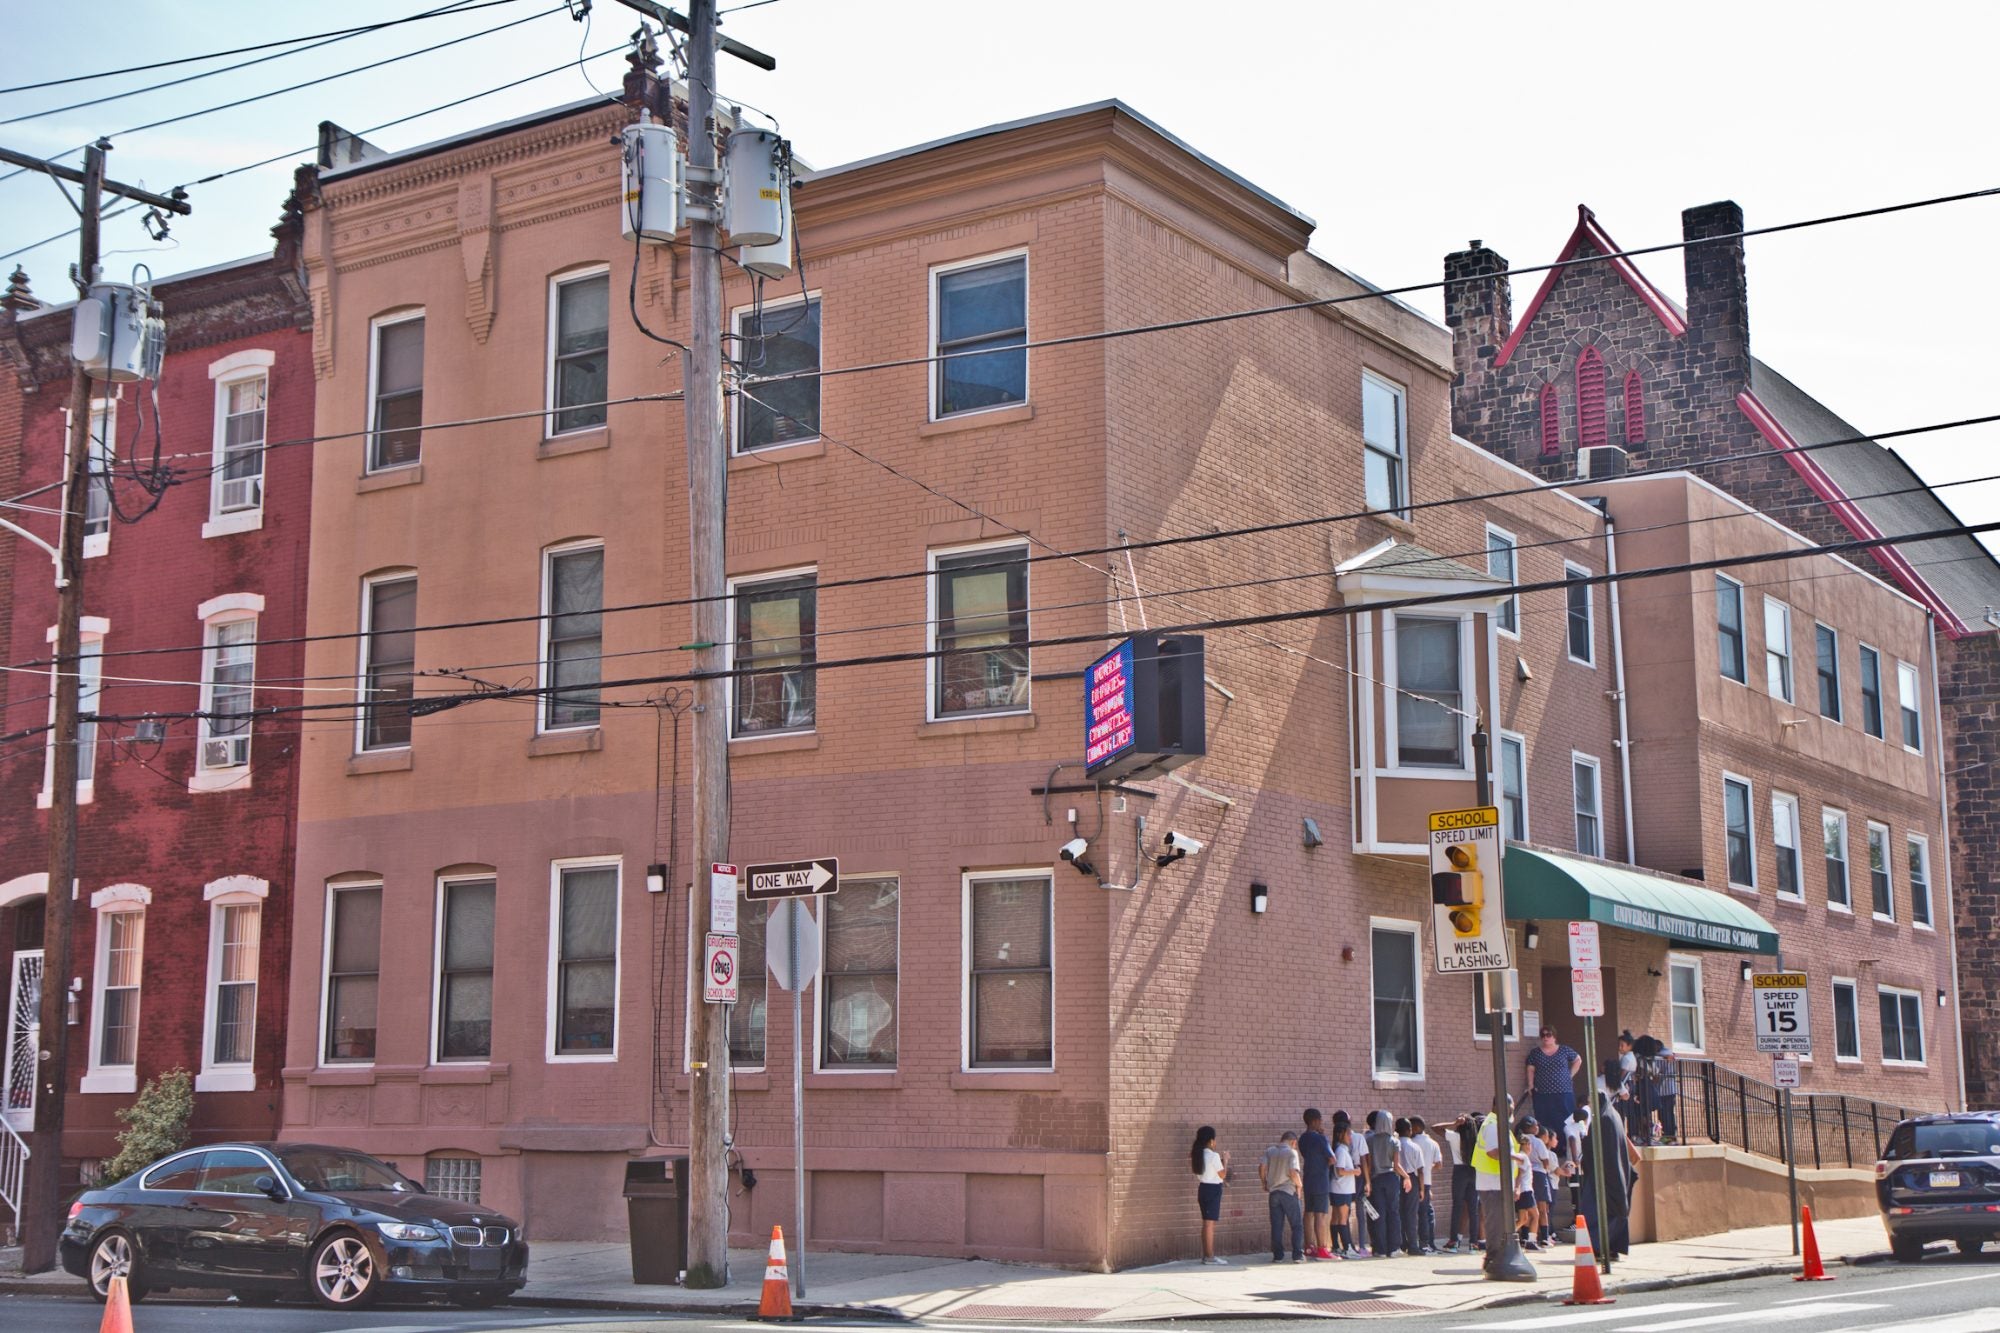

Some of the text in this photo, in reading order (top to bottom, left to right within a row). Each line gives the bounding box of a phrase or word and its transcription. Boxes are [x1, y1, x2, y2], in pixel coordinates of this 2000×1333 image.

[1438, 812, 1490, 828] SCHOOL
[1435, 827, 1493, 844] SPEED LIMIT
[755, 871, 811, 889] ONE WAY
[1613, 904, 1759, 949] UNIVERSAL INSTITUTE CHARTER SCHOOL
[708, 937, 737, 949] DRUG-FREE
[1454, 941, 1488, 954] WHEN
[715, 962, 730, 974] DRUGS
[1443, 954, 1502, 969] FLASHING
[1756, 976, 1804, 986] SCHOOL
[707, 988, 736, 998] SCHOOL ZONE
[1763, 992, 1799, 1000] SPEED
[1767, 1011, 1798, 1033] 15
